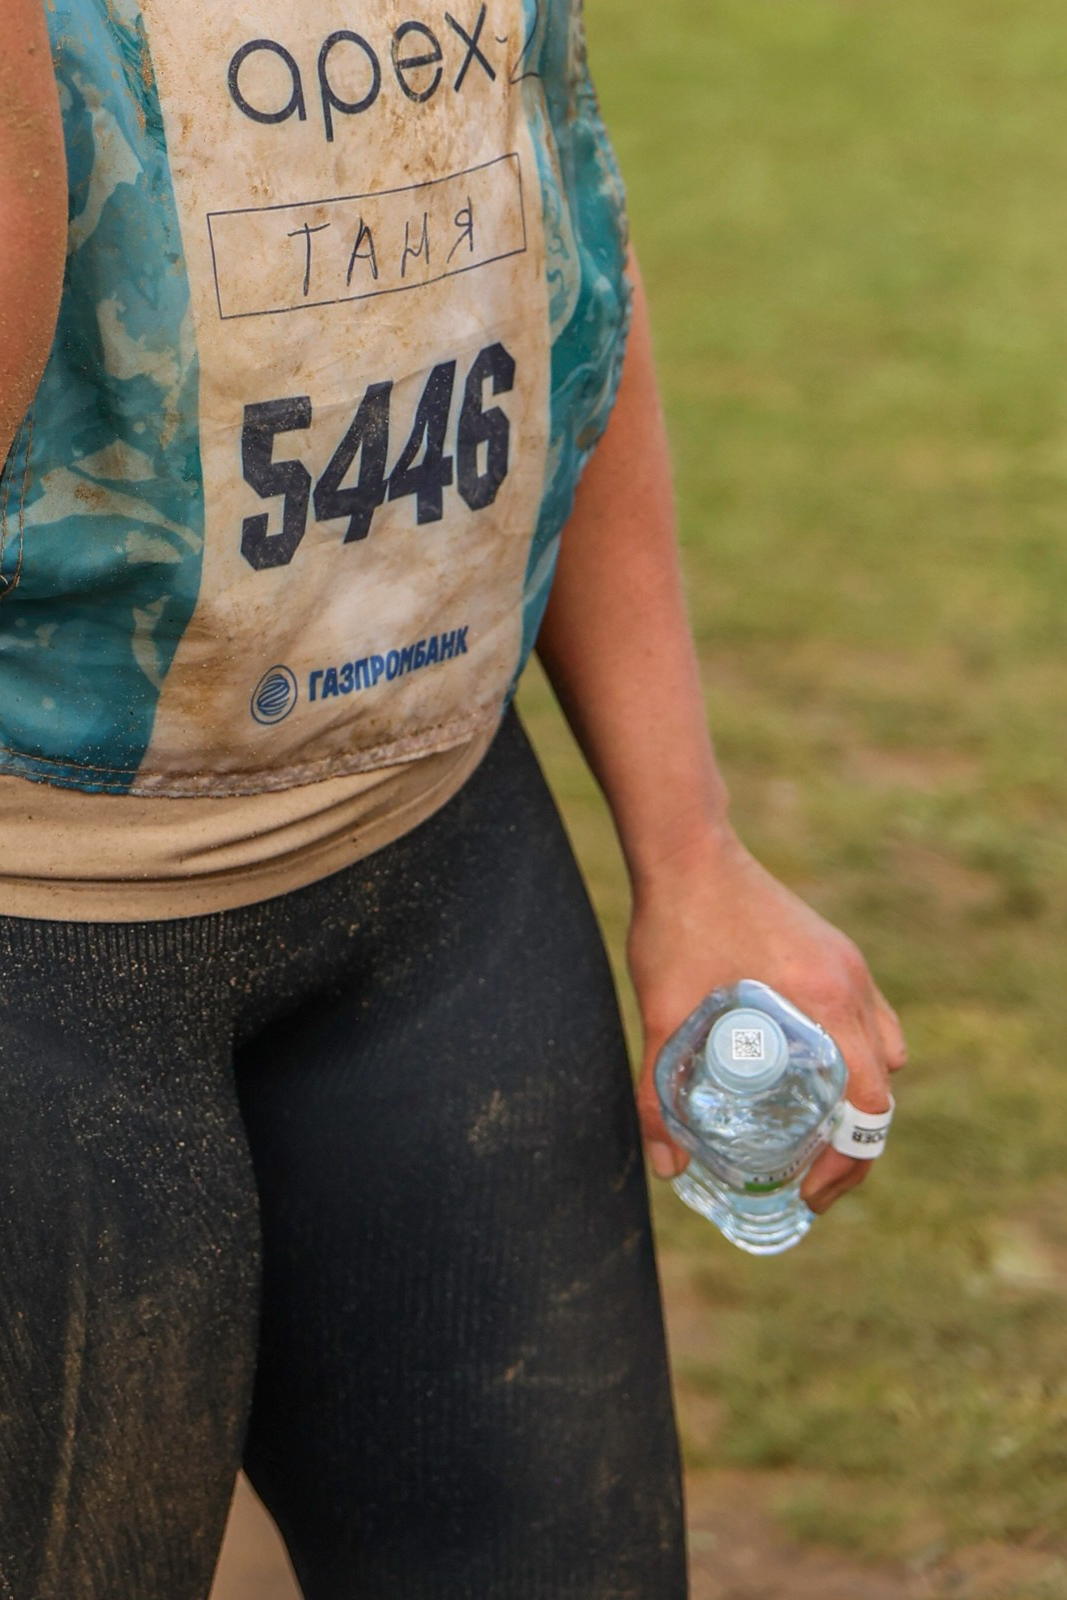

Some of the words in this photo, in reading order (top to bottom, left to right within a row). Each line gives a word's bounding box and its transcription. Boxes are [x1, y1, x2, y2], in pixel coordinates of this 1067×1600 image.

[227, 3, 496, 143] apex
[287, 196, 477, 297] ТАНЯ
[239, 341, 517, 572] 5446
[307, 625, 469, 703] ГАЗПРОМБАНК
